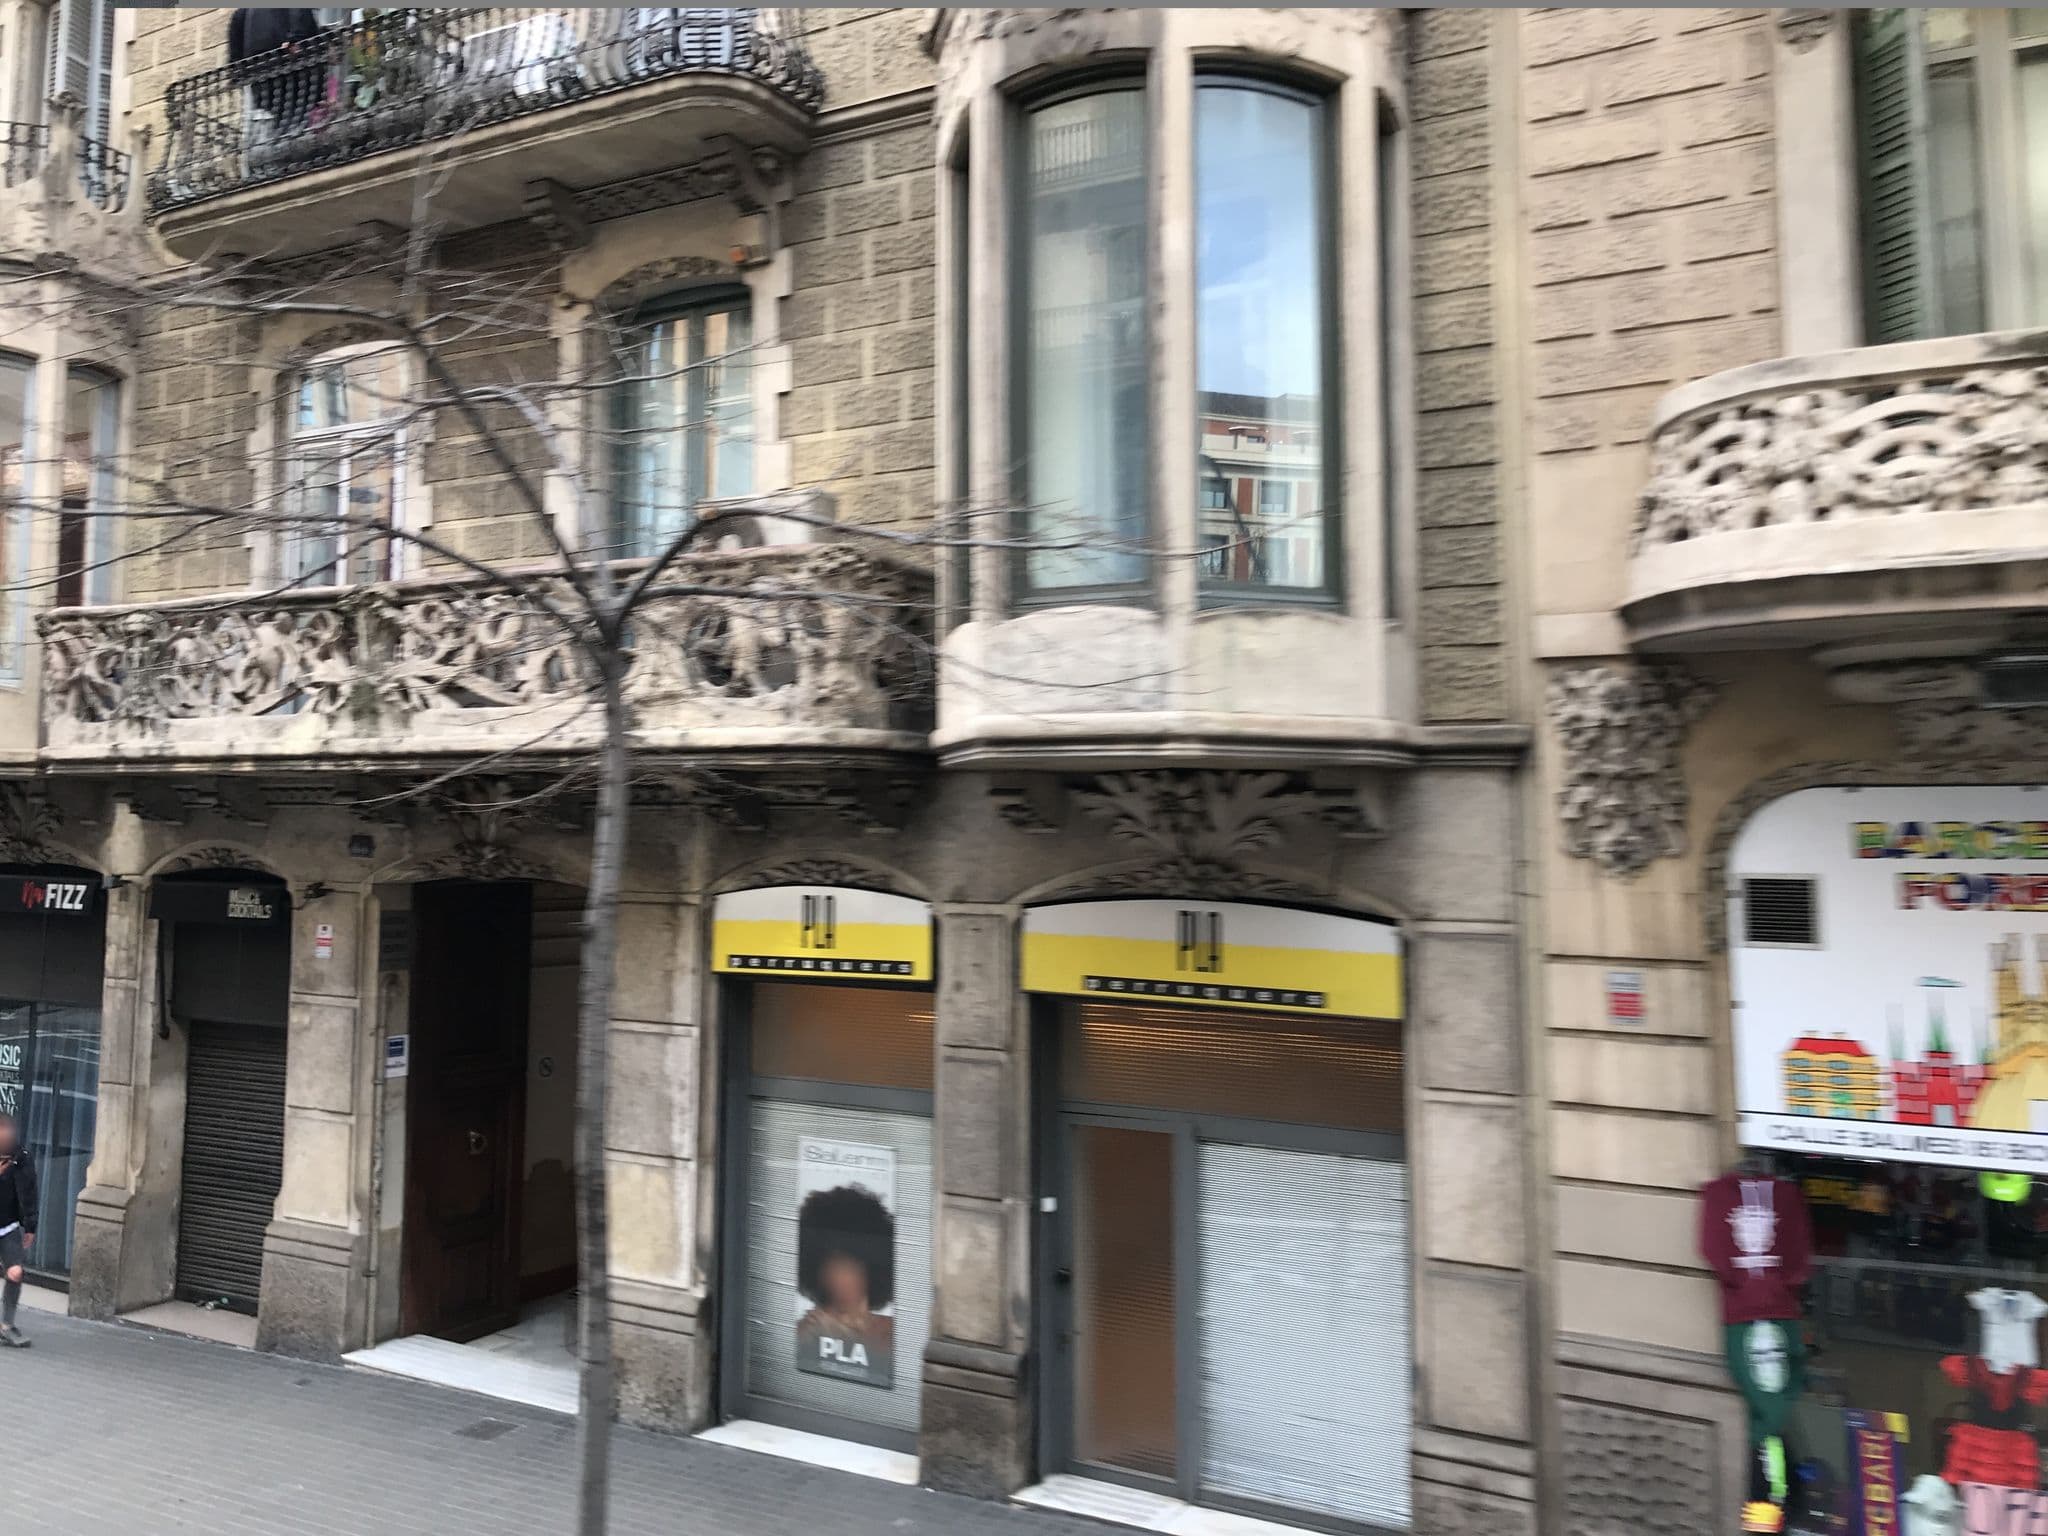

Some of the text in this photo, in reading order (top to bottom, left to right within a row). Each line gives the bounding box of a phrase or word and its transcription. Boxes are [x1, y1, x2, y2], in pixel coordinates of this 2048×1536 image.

[44, 883, 87, 910] FIZZ
[731, 956, 913, 974] perruquers
[1087, 978, 1323, 1007] perruquers
[1769, 1124, 1848, 1146] CALLE
[818, 1335, 870, 1367] PLA
